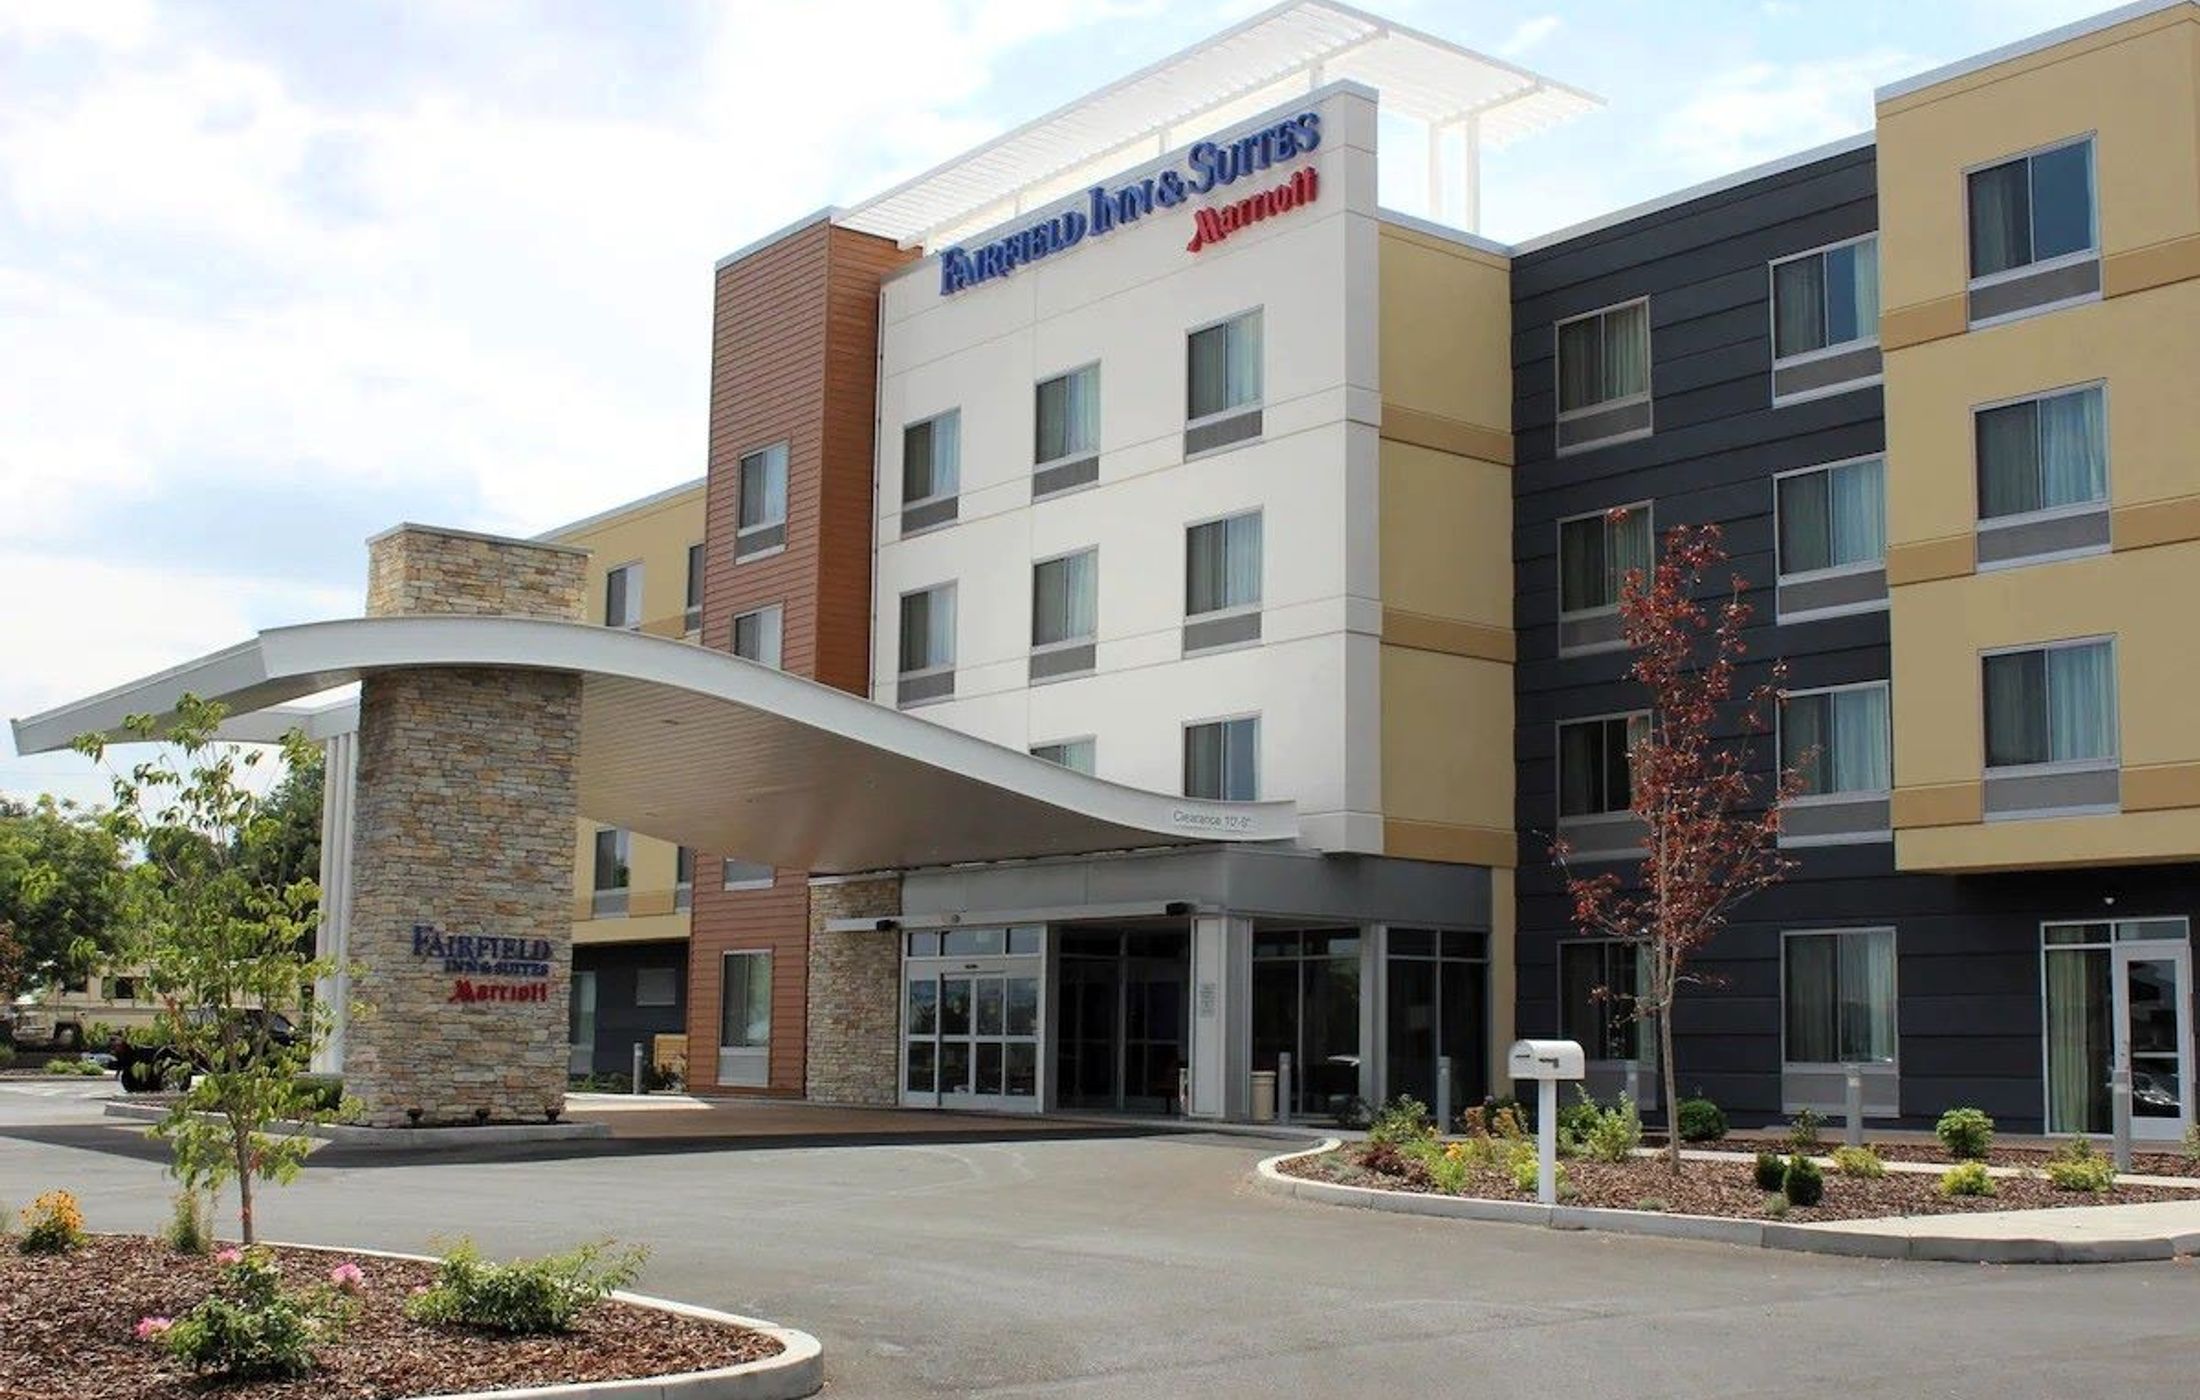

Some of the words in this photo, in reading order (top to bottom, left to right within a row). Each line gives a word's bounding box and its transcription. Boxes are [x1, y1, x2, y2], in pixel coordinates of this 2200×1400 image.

[1187, 165, 1319, 253] Marriott
[940, 210, 1087, 296] FAIRFIELD
[413, 924, 553, 961] FAIRFIELD
[449, 979, 549, 1004] Marriott
